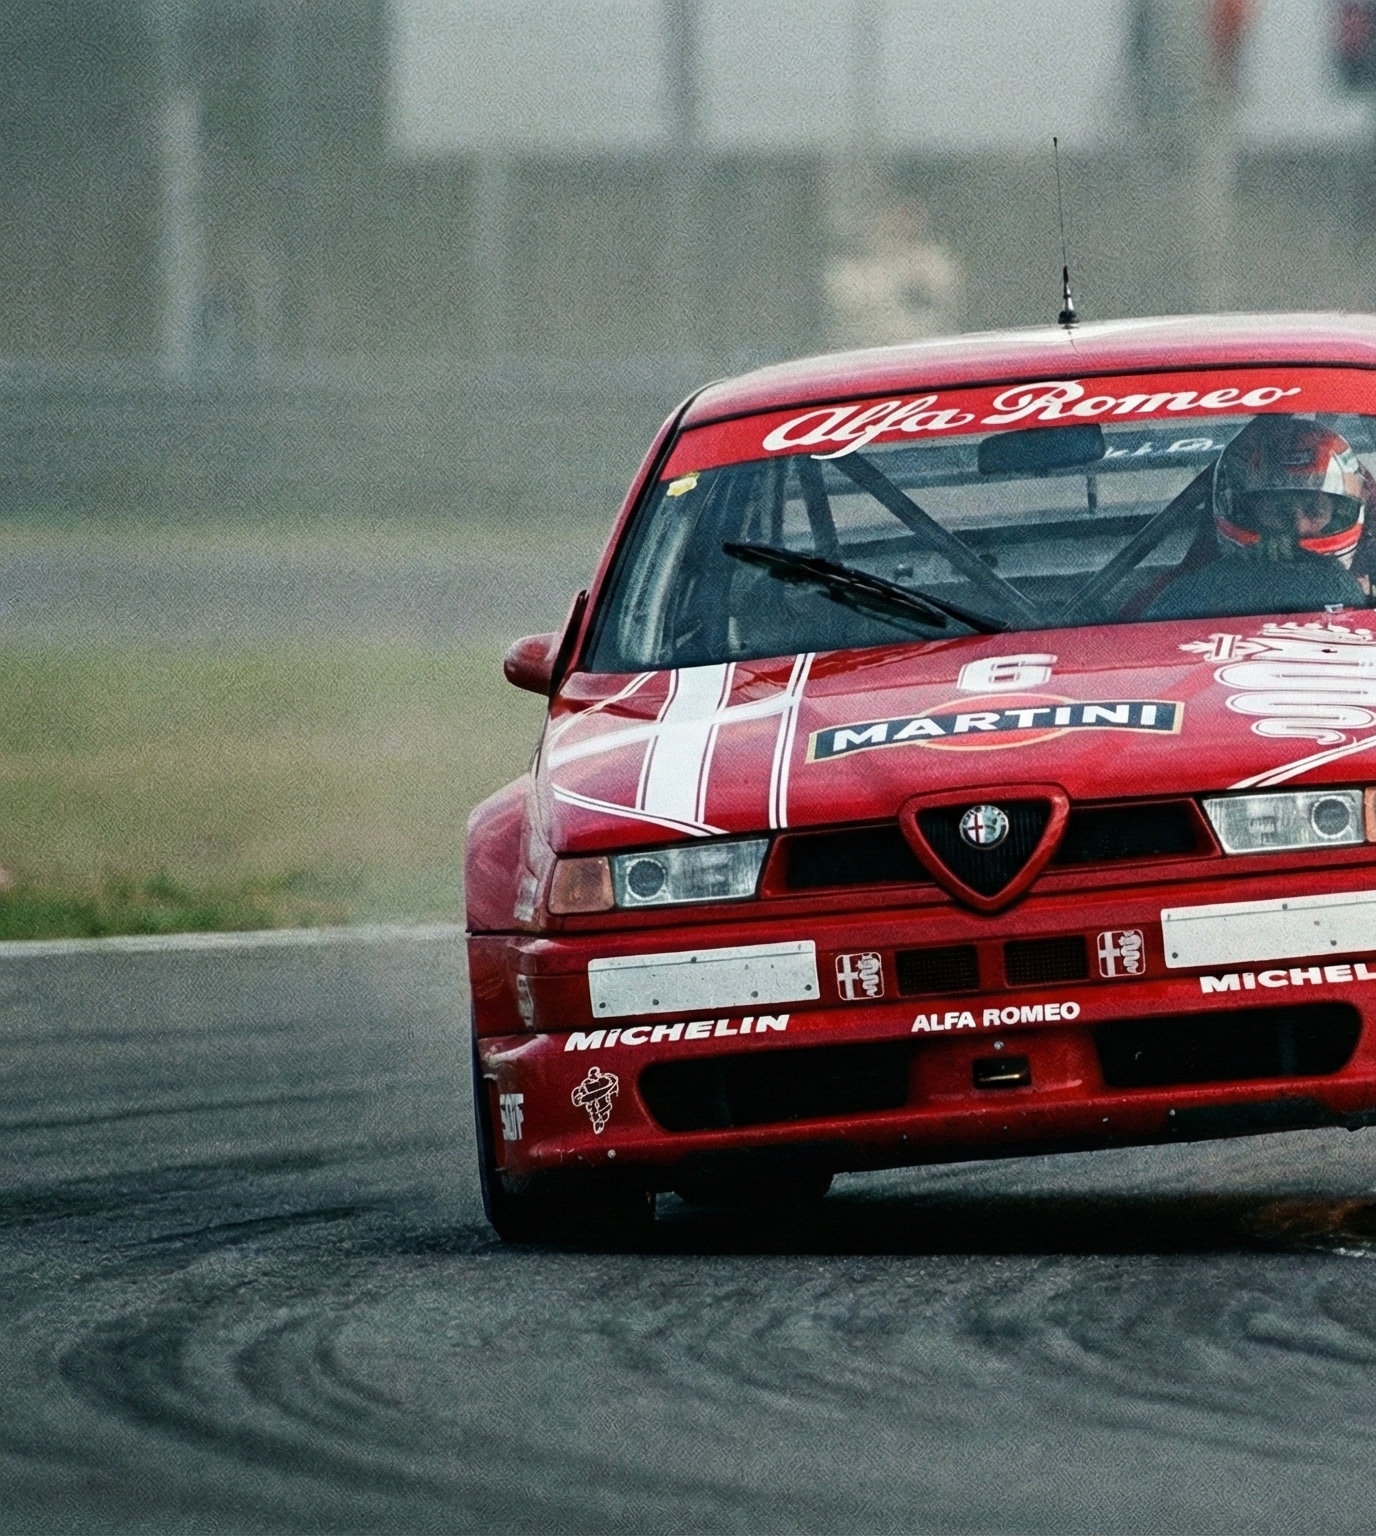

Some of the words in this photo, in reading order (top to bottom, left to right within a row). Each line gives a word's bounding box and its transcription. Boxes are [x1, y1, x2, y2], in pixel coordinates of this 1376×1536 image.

[762, 395, 976, 460] Alfa
[981, 379, 1302, 425] Romeo
[957, 653, 1058, 692] 6
[832, 705, 1157, 752] MARTINI
[564, 1014, 790, 1052] MICHELIN
[911, 1011, 976, 1032] ALFA
[982, 1001, 1081, 1026] ROMEO
